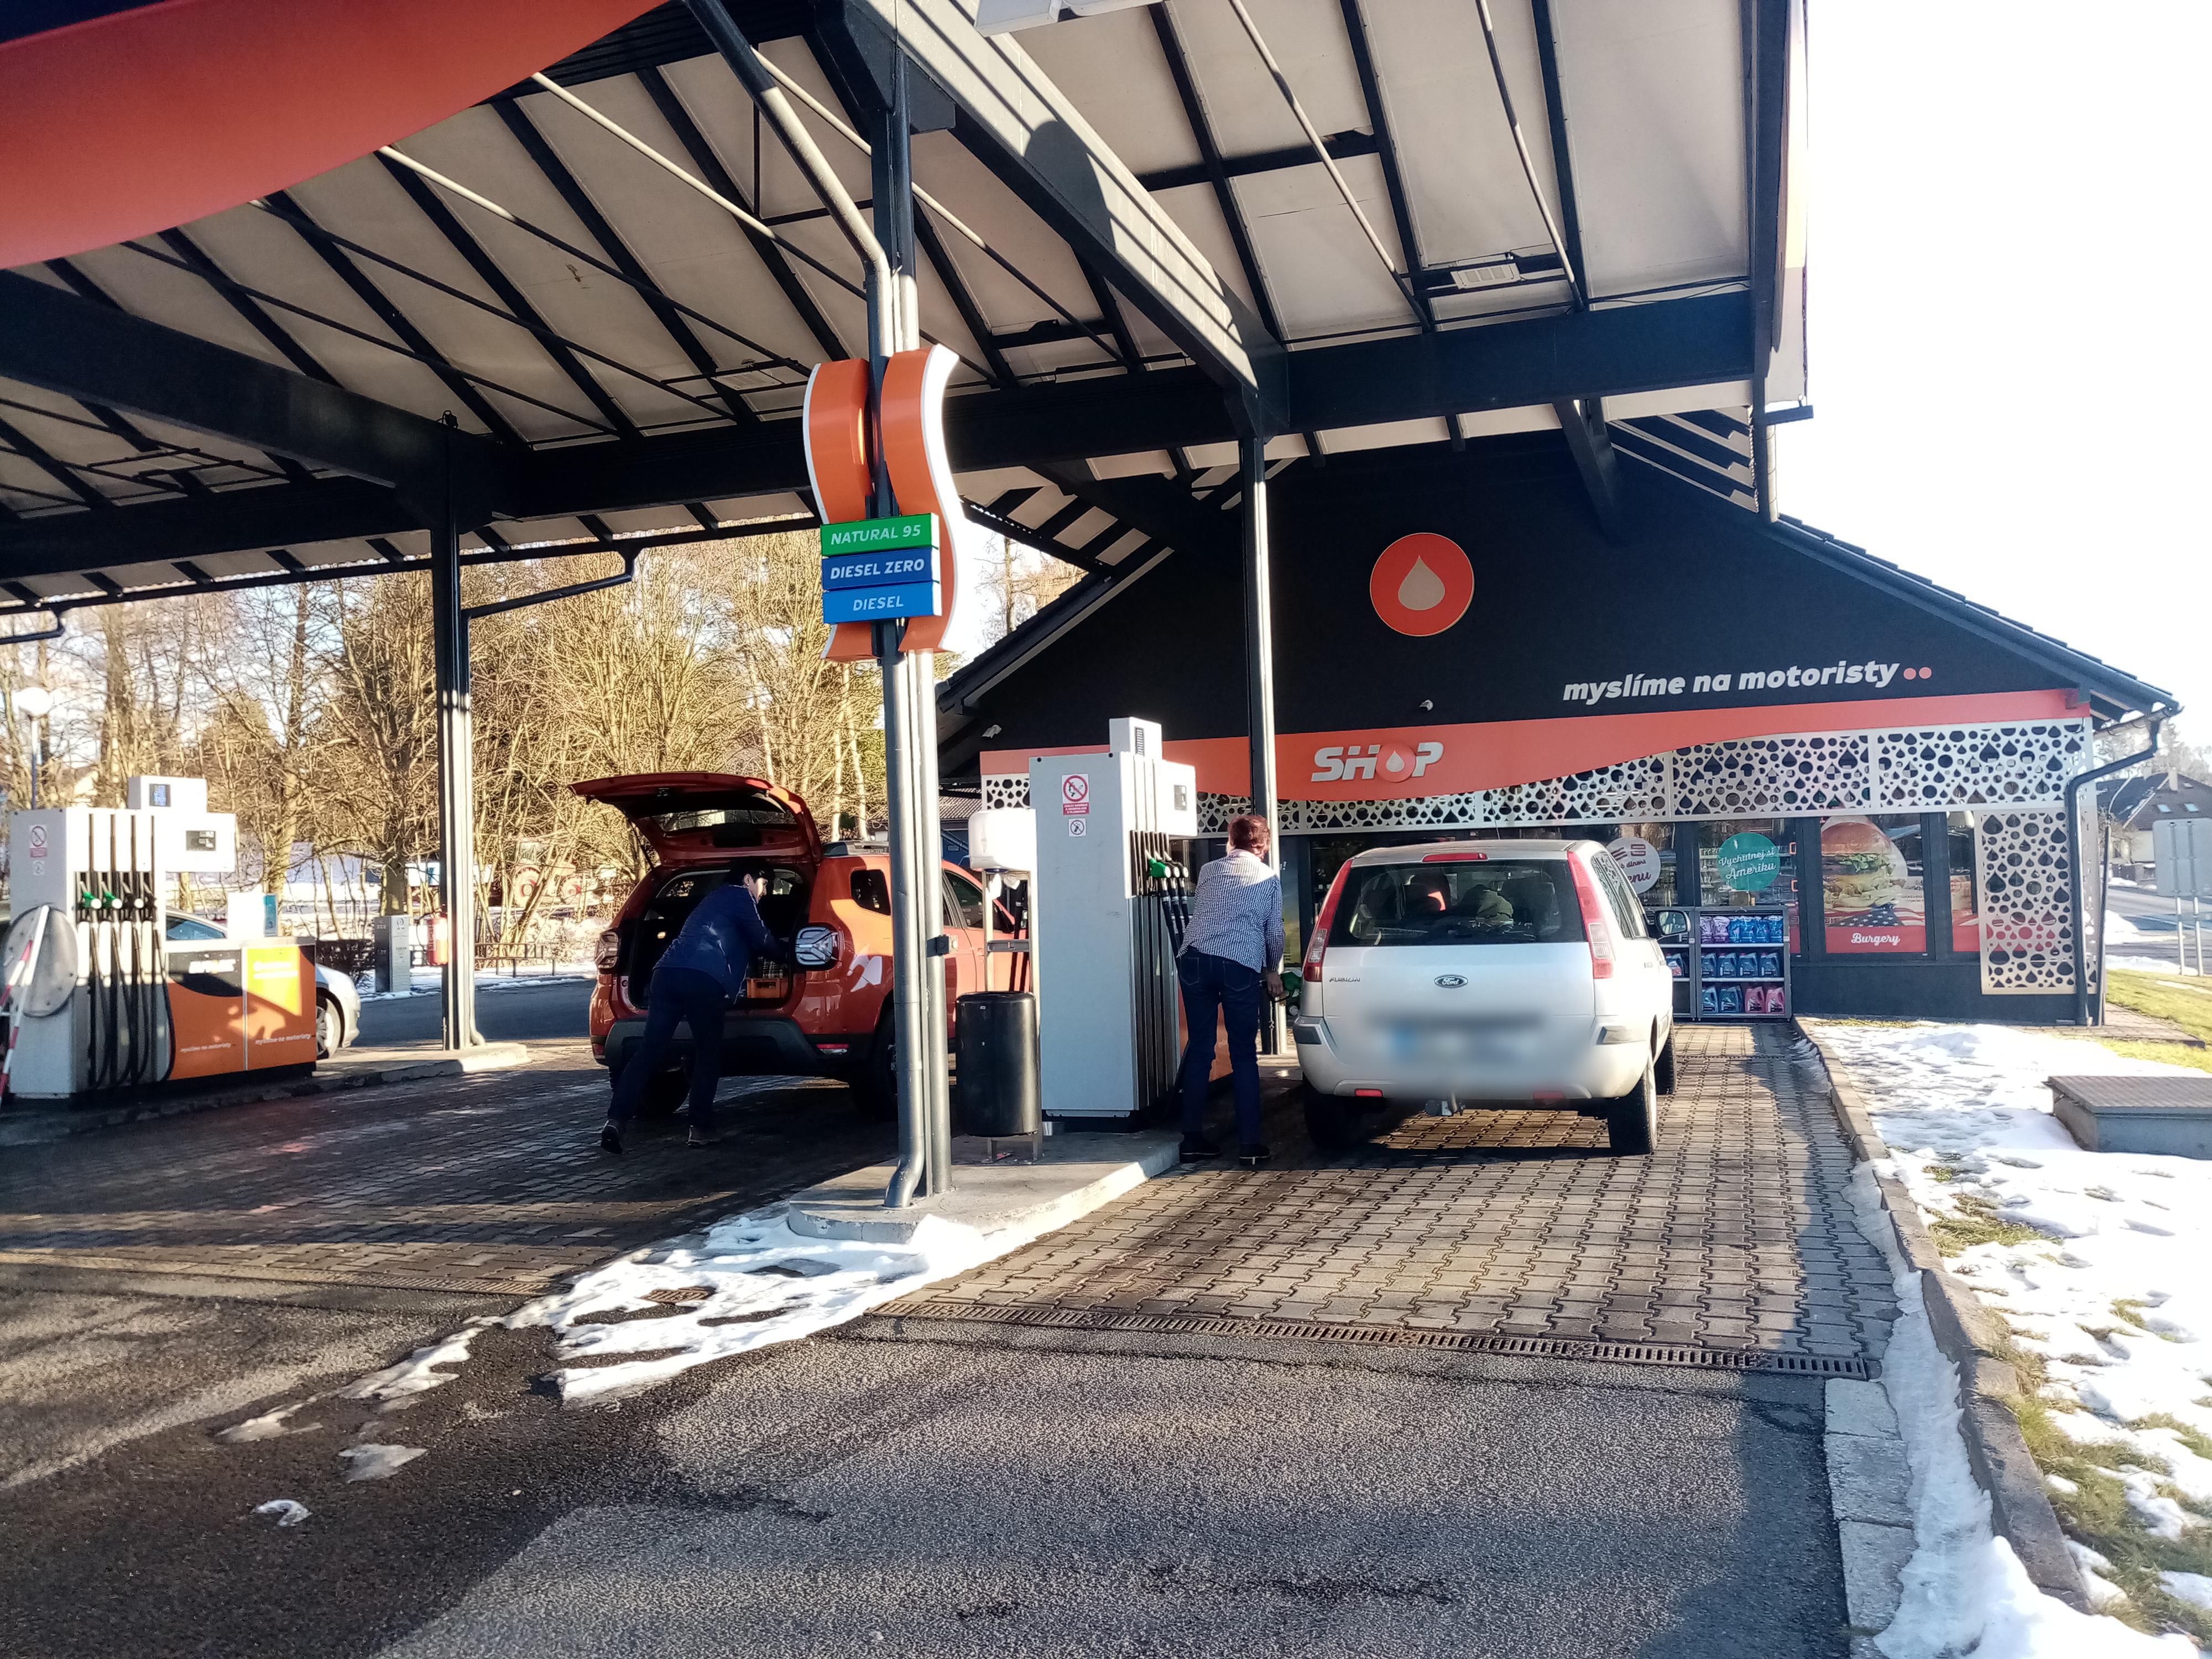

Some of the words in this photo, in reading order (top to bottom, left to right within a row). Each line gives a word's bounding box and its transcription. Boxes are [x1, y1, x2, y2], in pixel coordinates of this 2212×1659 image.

[831, 528, 899, 545] NATURAL
[902, 525, 921, 538] 95
[831, 563, 880, 580] DIESEL
[884, 559, 925, 574] ZERO
[853, 596, 904, 611] DIESEL
[1563, 673, 1685, 705] myslíme
[1693, 671, 1731, 693] na
[1739, 660, 1900, 690] motoristy
[1311, 742, 1444, 782] SHOP
[1718, 849, 1767, 867] Vychutnej
[1766, 847, 1775, 857] si
[1627, 872, 1651, 883] enu
[1725, 862, 1776, 879] Ameriku
[1851, 932, 1901, 946] Burgery
